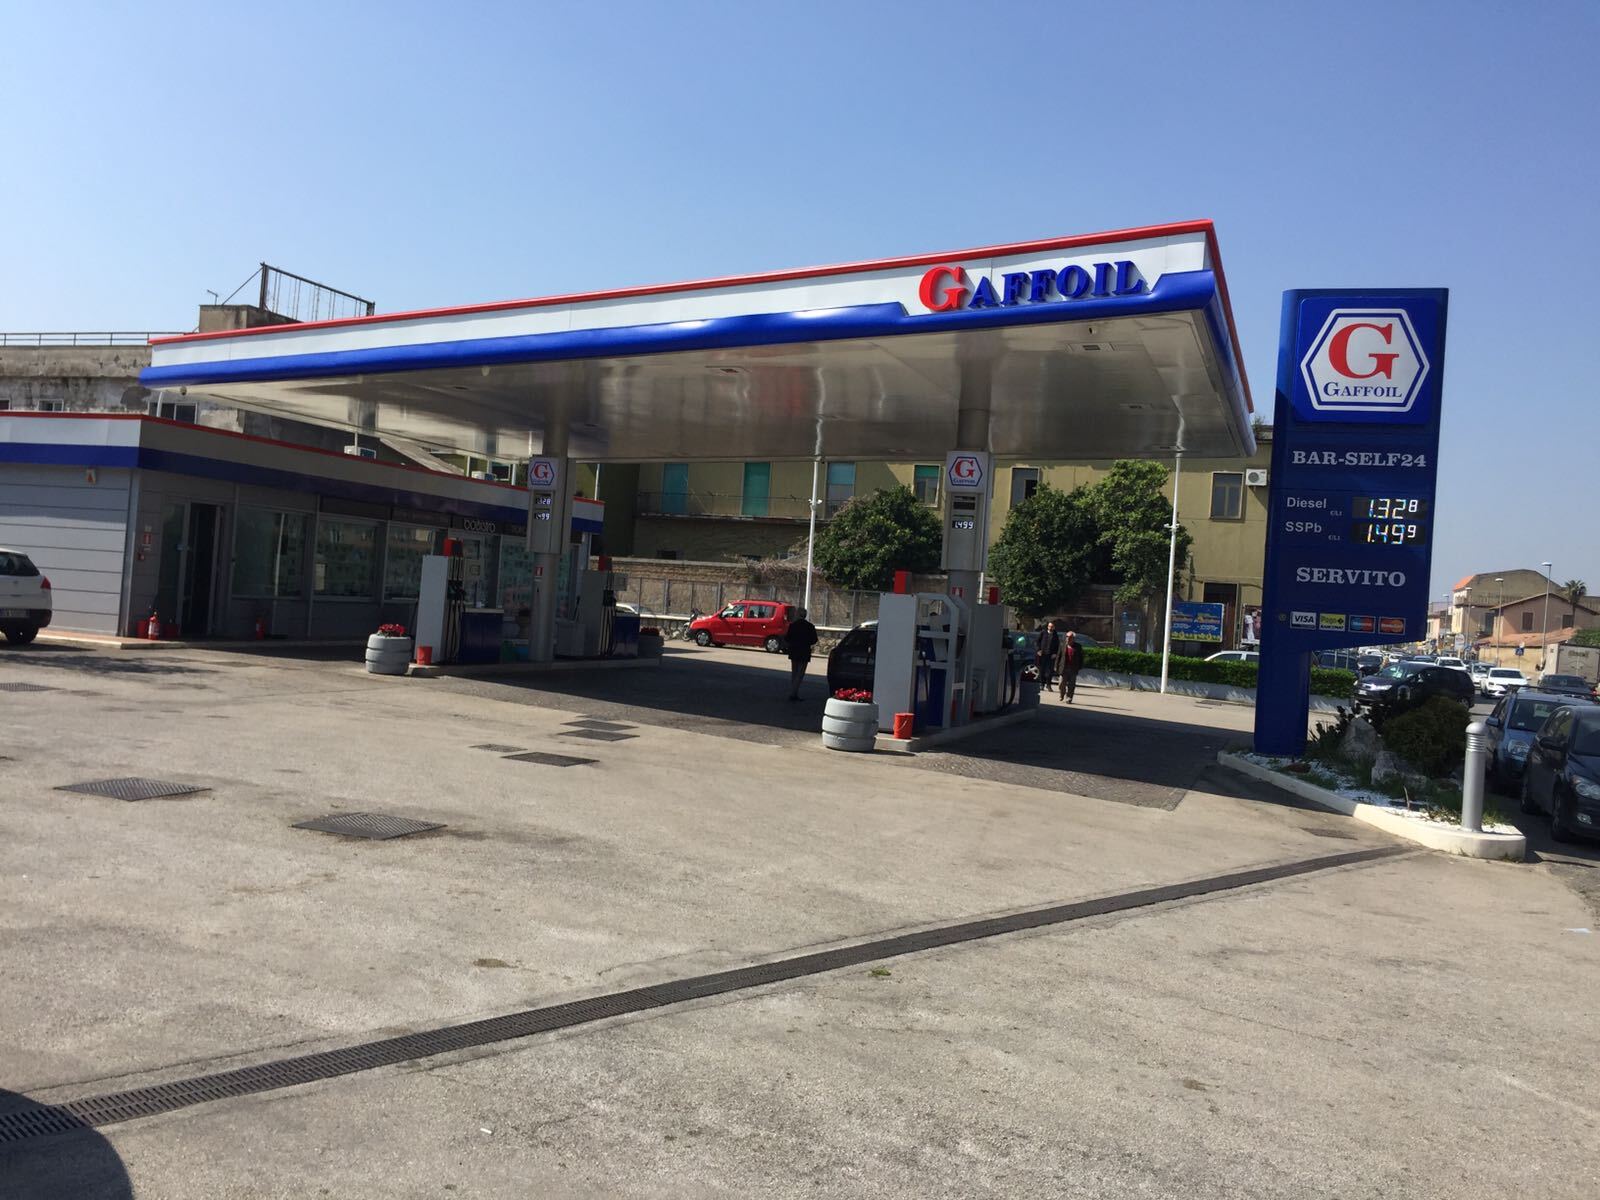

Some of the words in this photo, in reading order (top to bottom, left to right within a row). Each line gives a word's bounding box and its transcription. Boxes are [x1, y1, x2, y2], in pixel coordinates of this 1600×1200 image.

[918, 260, 1144, 312] GAFFOIL
[1328, 322, 1399, 379] G
[1323, 381, 1403, 398] GAFFOIL
[1291, 450, 1427, 468] BAR-SELF24
[955, 459, 975, 478] G
[1286, 497, 1327, 509] Diesel
[1284, 521, 1322, 533] SSPb
[1295, 567, 1406, 588] SERVITO
[1294, 615, 1314, 624] VISA
